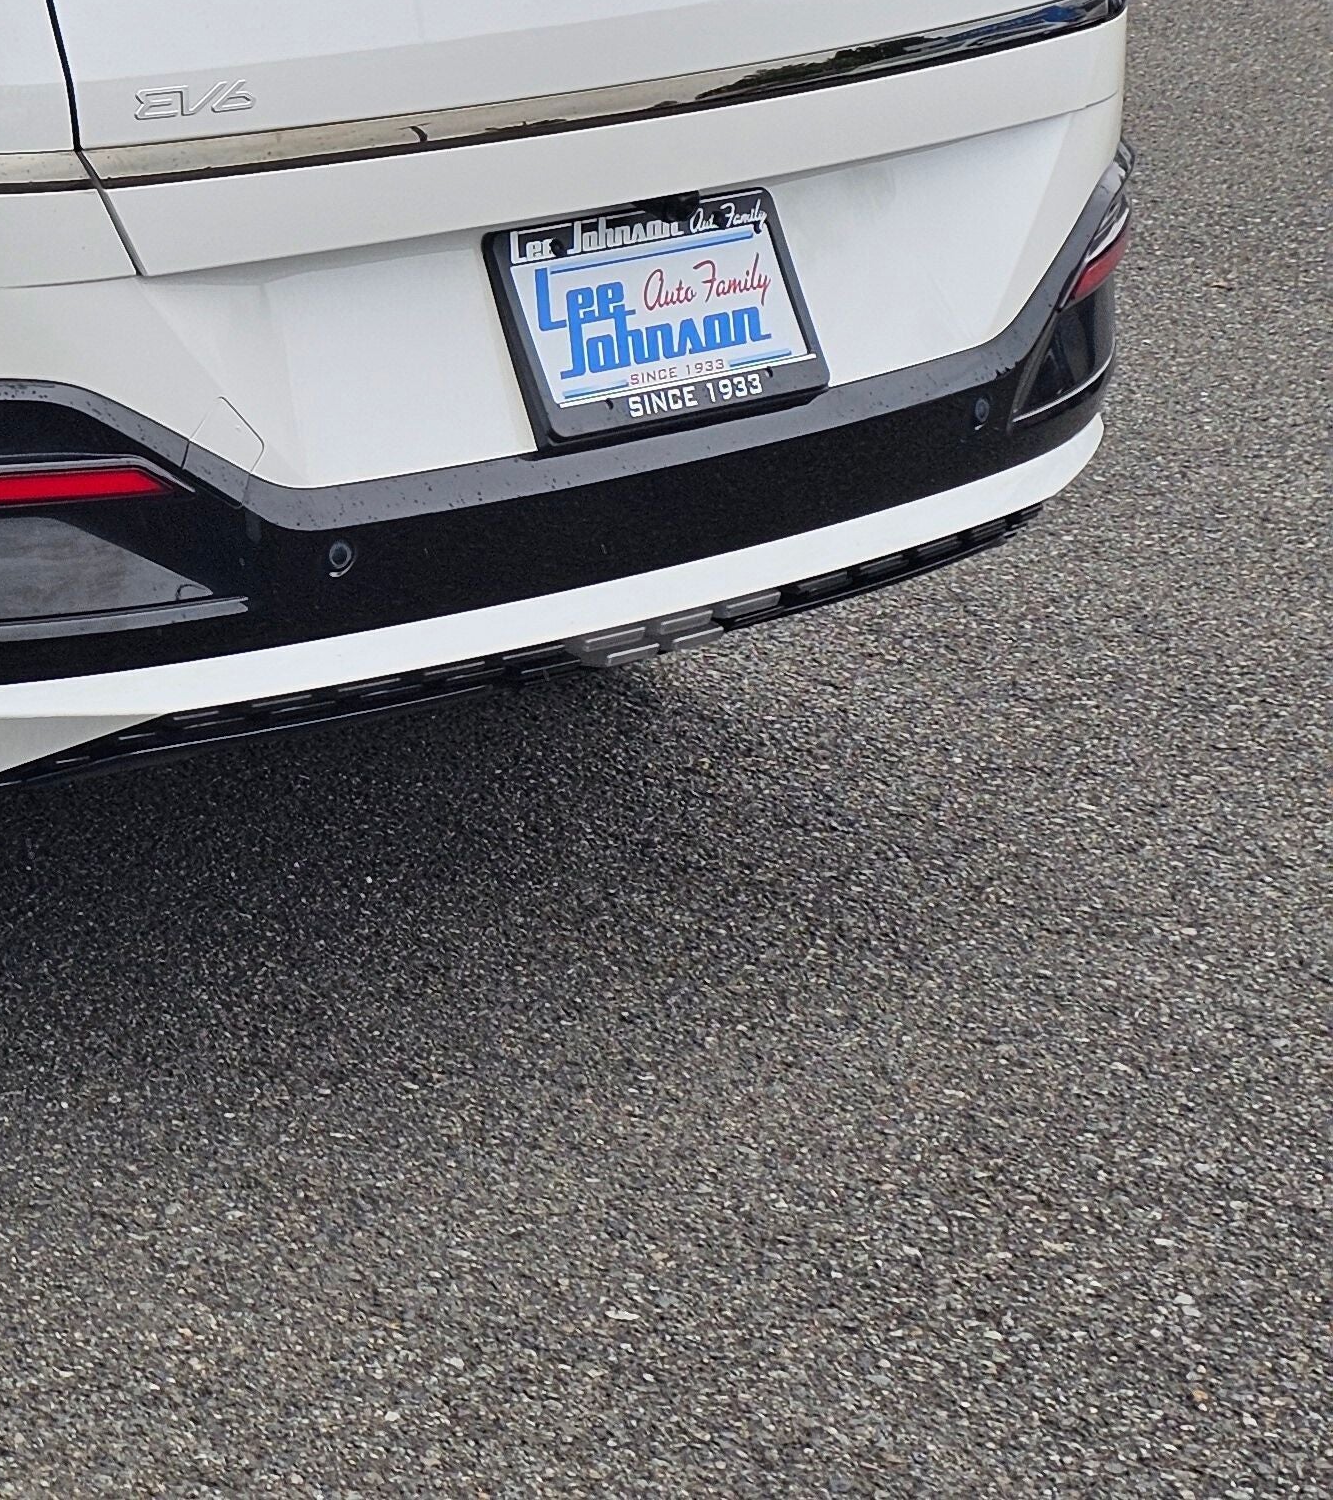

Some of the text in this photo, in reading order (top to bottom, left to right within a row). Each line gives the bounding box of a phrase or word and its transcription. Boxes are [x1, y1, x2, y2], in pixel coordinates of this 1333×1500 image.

[133, 78, 257, 121] EV6
[534, 251, 772, 332] Lee Auto Family
[560, 304, 772, 380] Johnson
[630, 357, 725, 387] SINCE 1933
[628, 373, 764, 418] SINCE 1933
